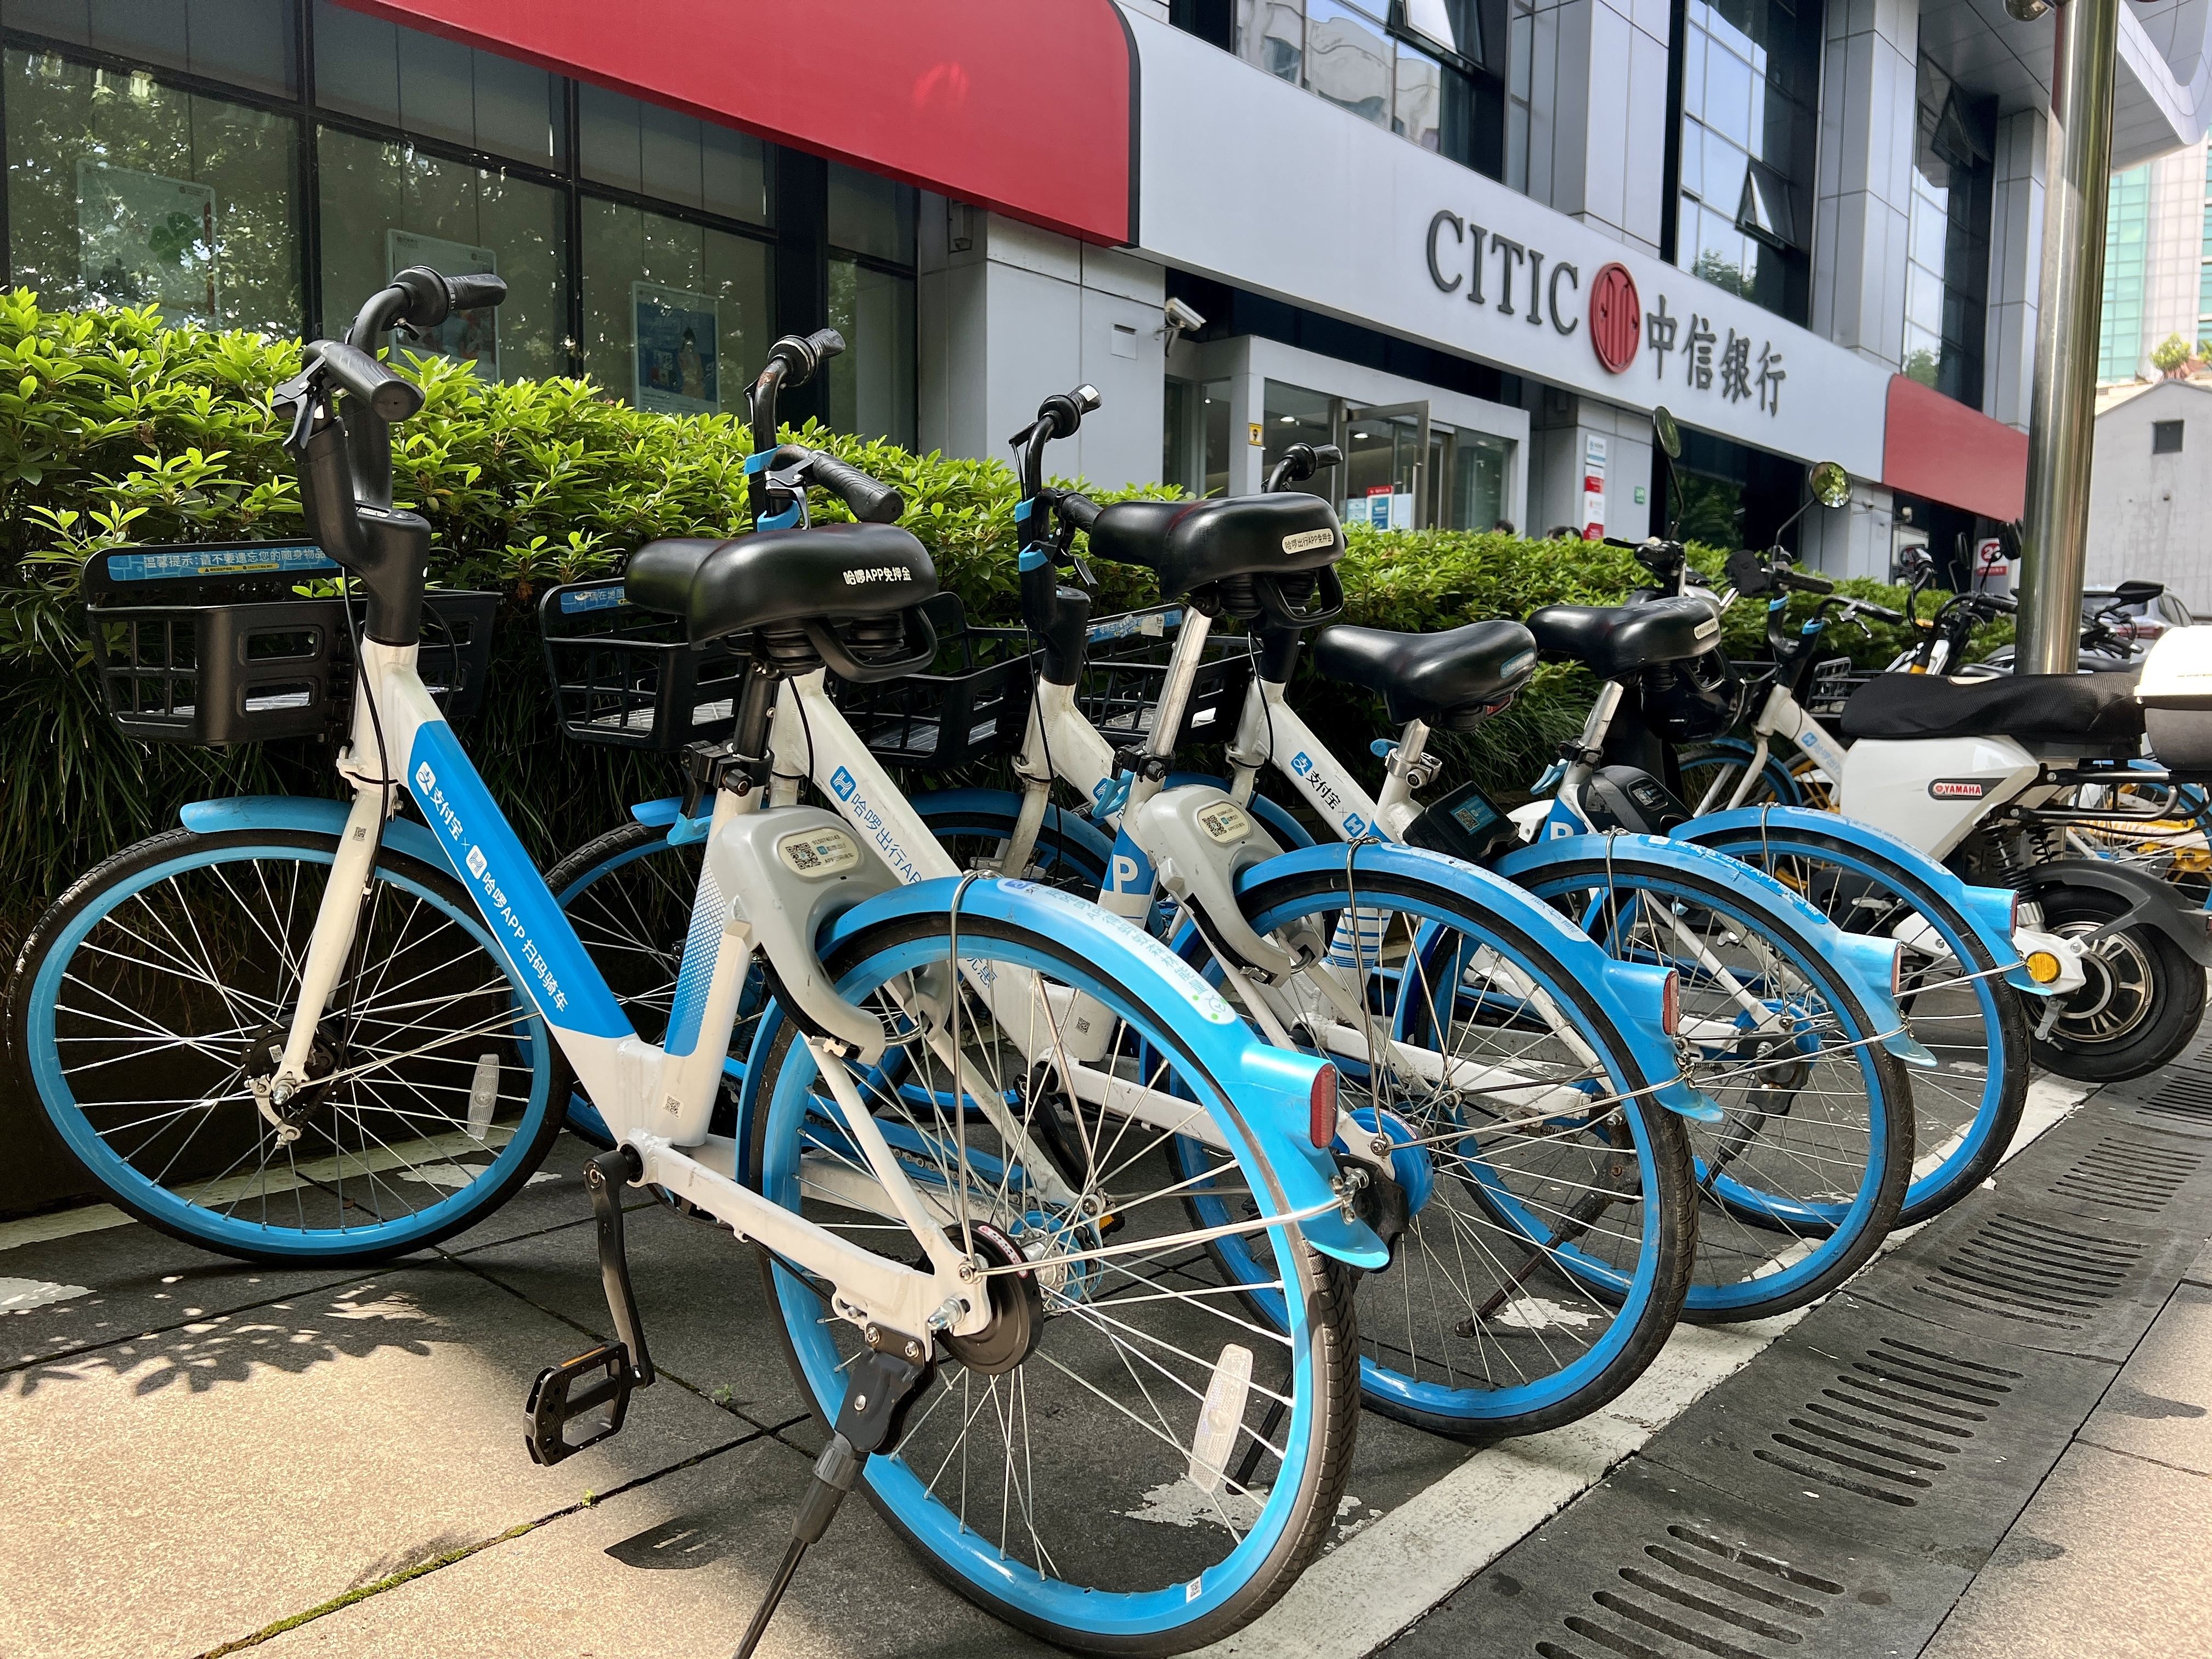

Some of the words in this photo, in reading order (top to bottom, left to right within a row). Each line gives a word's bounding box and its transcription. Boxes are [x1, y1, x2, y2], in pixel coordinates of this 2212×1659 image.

[1427, 210, 1578, 335] CITIC
[1646, 294, 1787, 417] 中信银行
[843, 567, 912, 585] 哈啰APP免押金
[1306, 770, 1341, 810] 支付宝
[1944, 785, 1980, 794] YAMAHA
[430, 786, 464, 841] 支付宝
[1113, 854, 1138, 893] P
